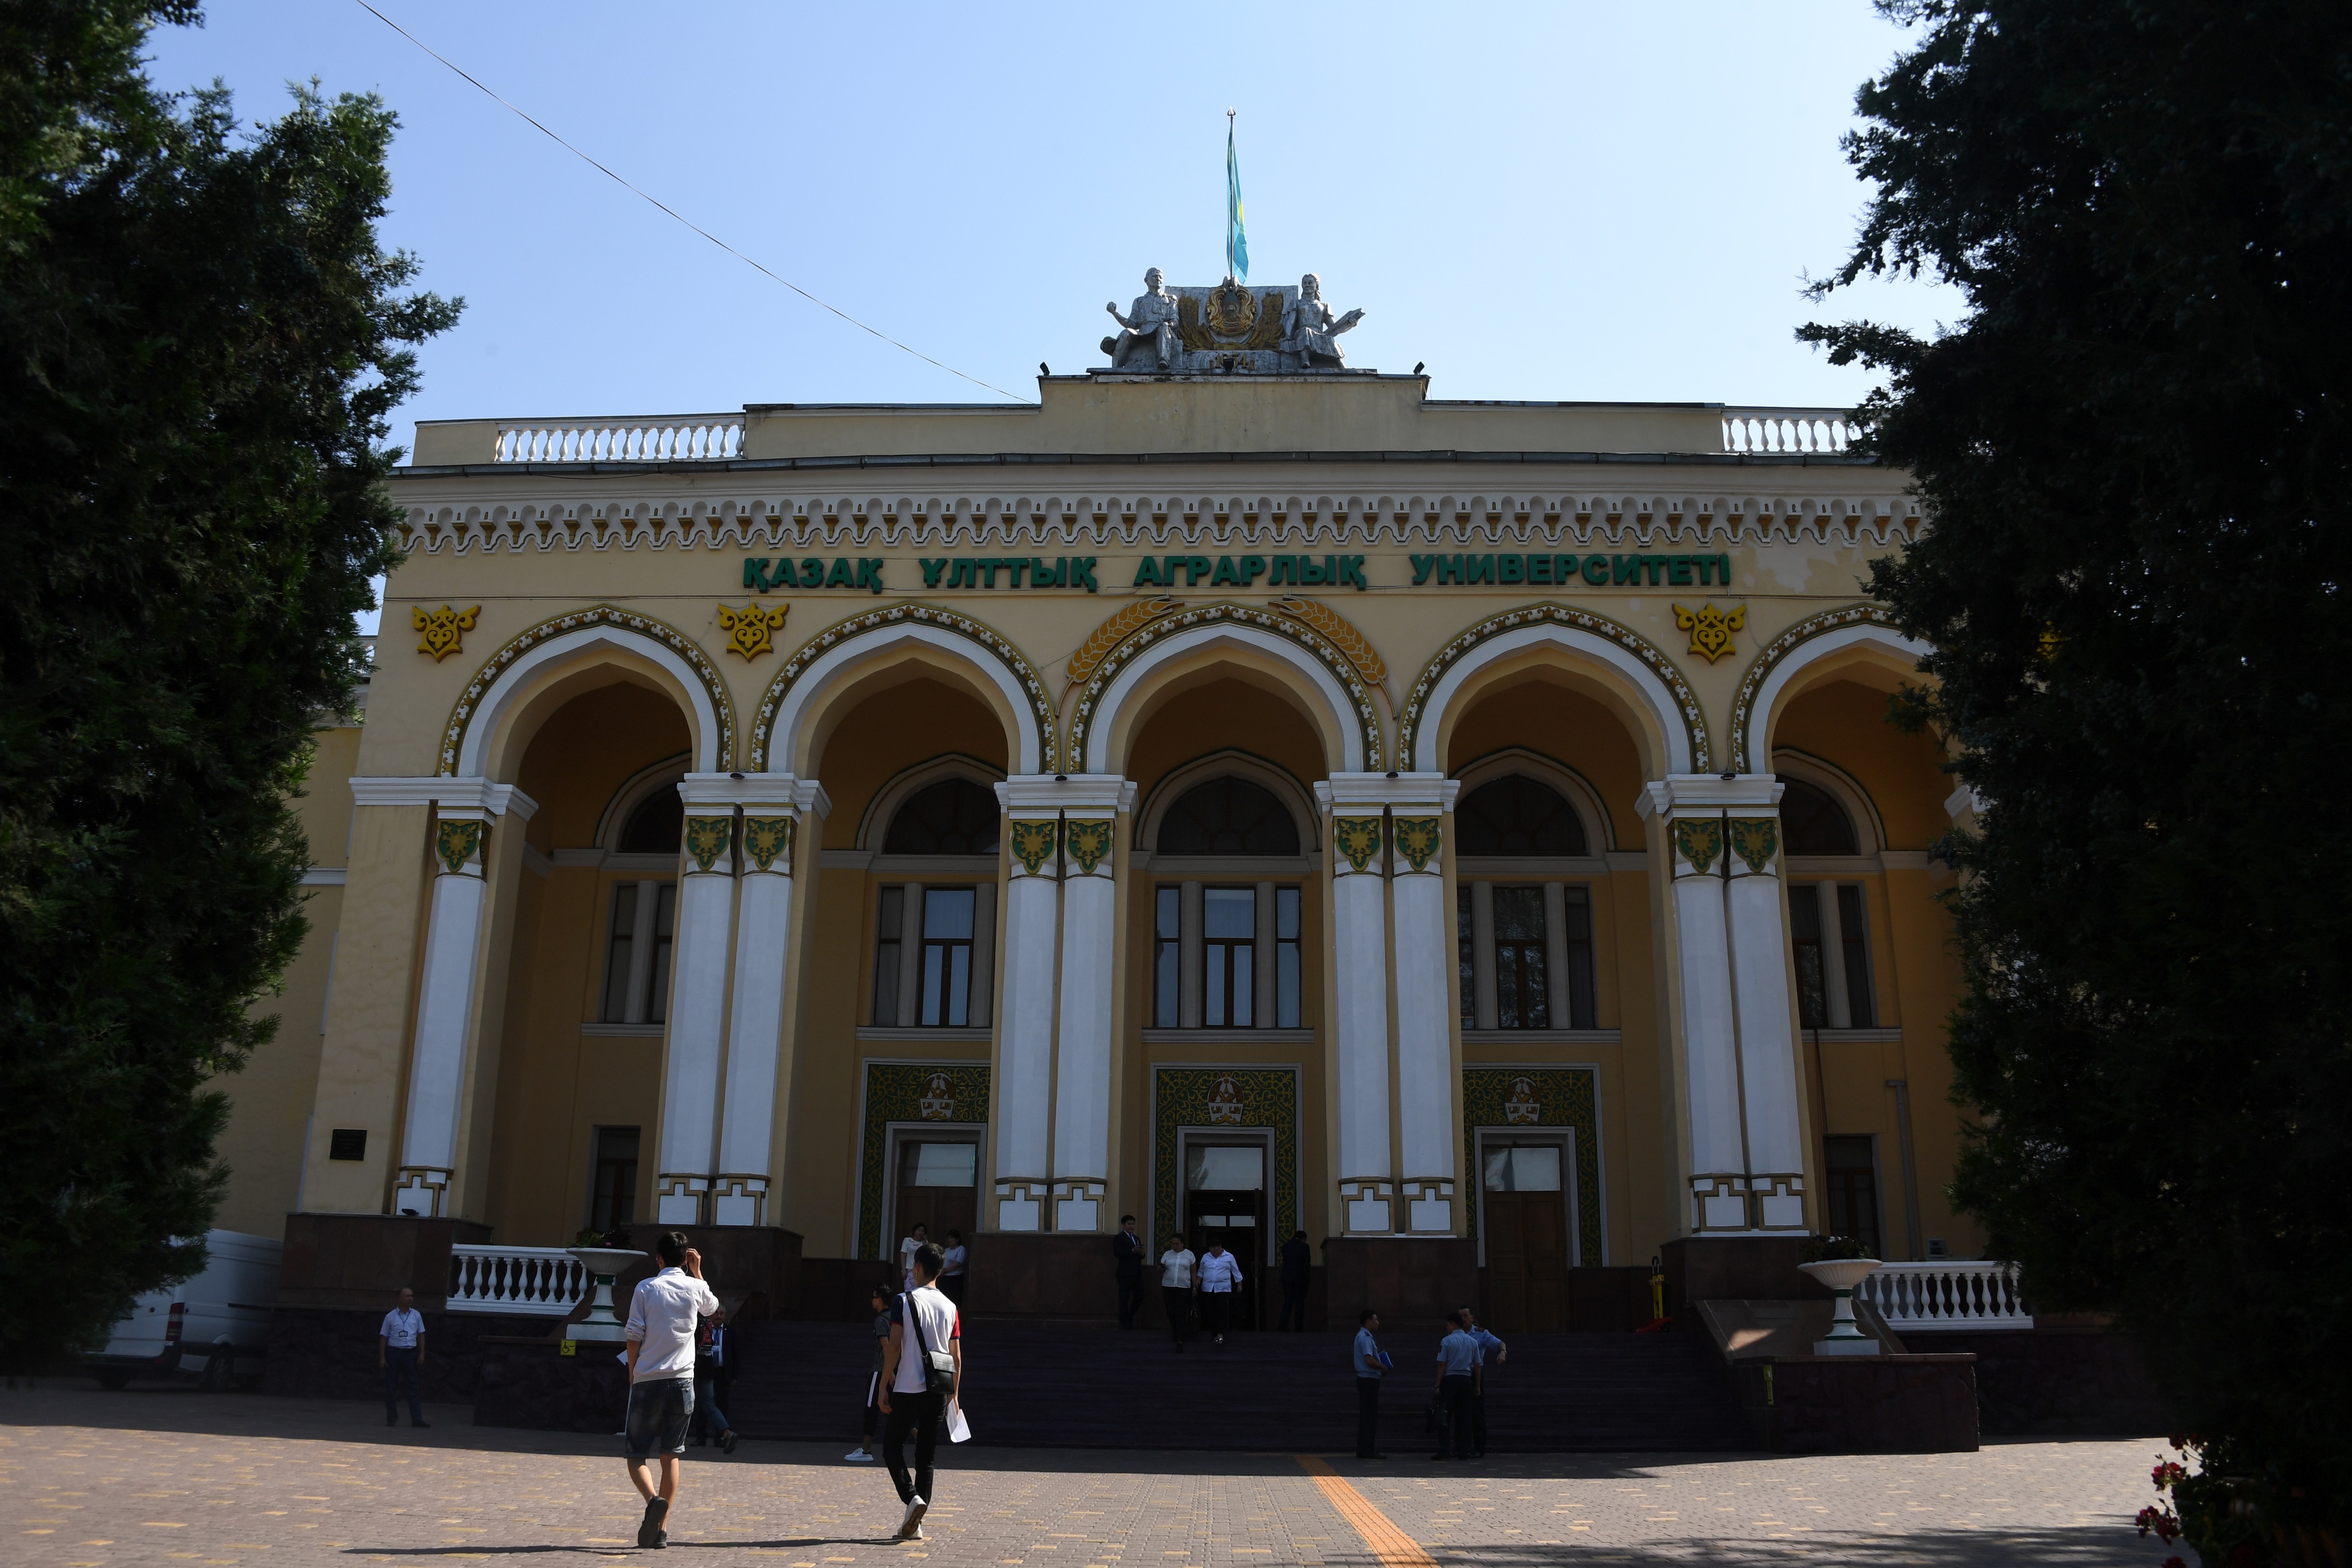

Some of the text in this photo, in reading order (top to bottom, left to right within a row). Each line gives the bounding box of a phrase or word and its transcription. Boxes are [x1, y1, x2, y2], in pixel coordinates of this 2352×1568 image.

[743, 553, 1730, 594] ҚАЗАҚ ҰЛТТЫҚ АГРАРЛЫҚ УНИВЕРСИТЕТІ
